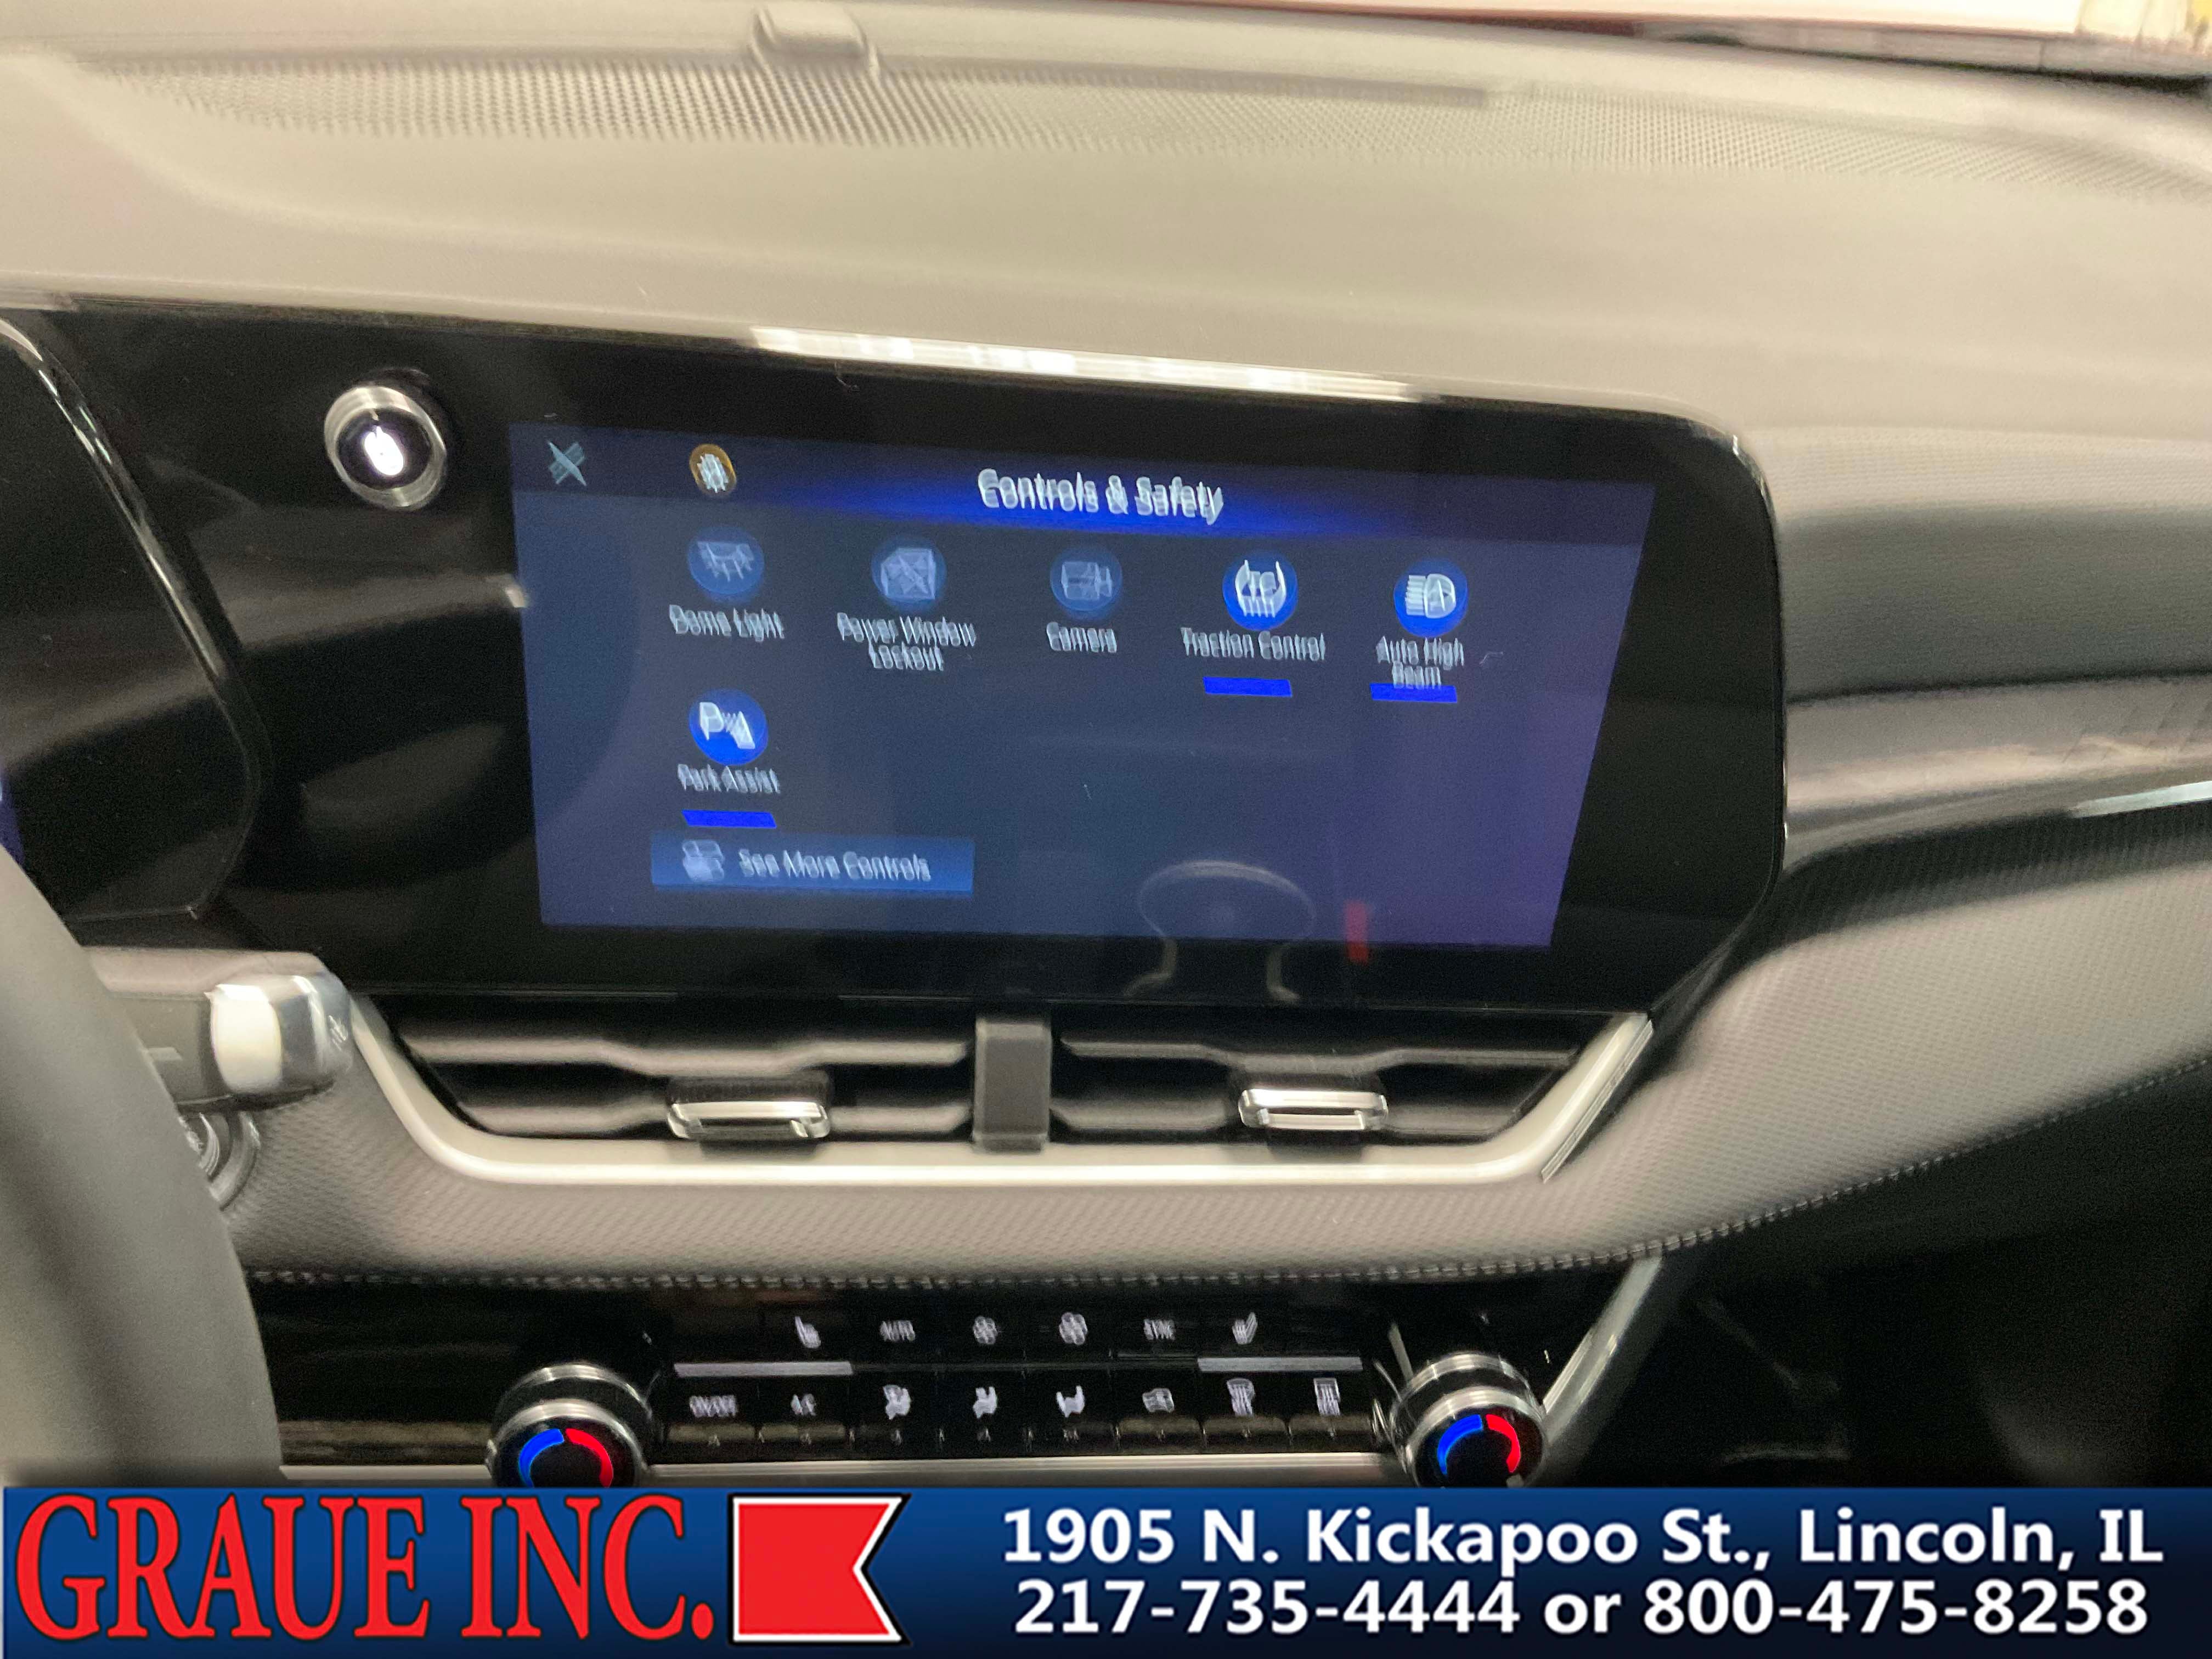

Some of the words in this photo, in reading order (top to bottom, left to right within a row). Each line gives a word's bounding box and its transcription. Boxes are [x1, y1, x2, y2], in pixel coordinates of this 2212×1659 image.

[978, 469, 1099, 512] Controls
[1105, 475, 1128, 515] &
[1135, 476, 1224, 525] Safety
[669, 605, 731, 636] Dome
[733, 608, 785, 642] Light
[837, 612, 899, 644] Power
[900, 616, 976, 647] Window
[1046, 622, 1117, 653] Camera
[868, 641, 944, 671] Lockout
[1181, 627, 1254, 659] Traction
[1258, 630, 1326, 661] Control
[1376, 636, 1419, 665] Auto
[1423, 637, 1464, 670] High
[1391, 661, 1442, 690] Beam
[678, 764, 721, 792] Park
[721, 765, 781, 794] Assist
[739, 849, 780, 877] See
[783, 850, 840, 878] More
[843, 851, 931, 882] Controls
